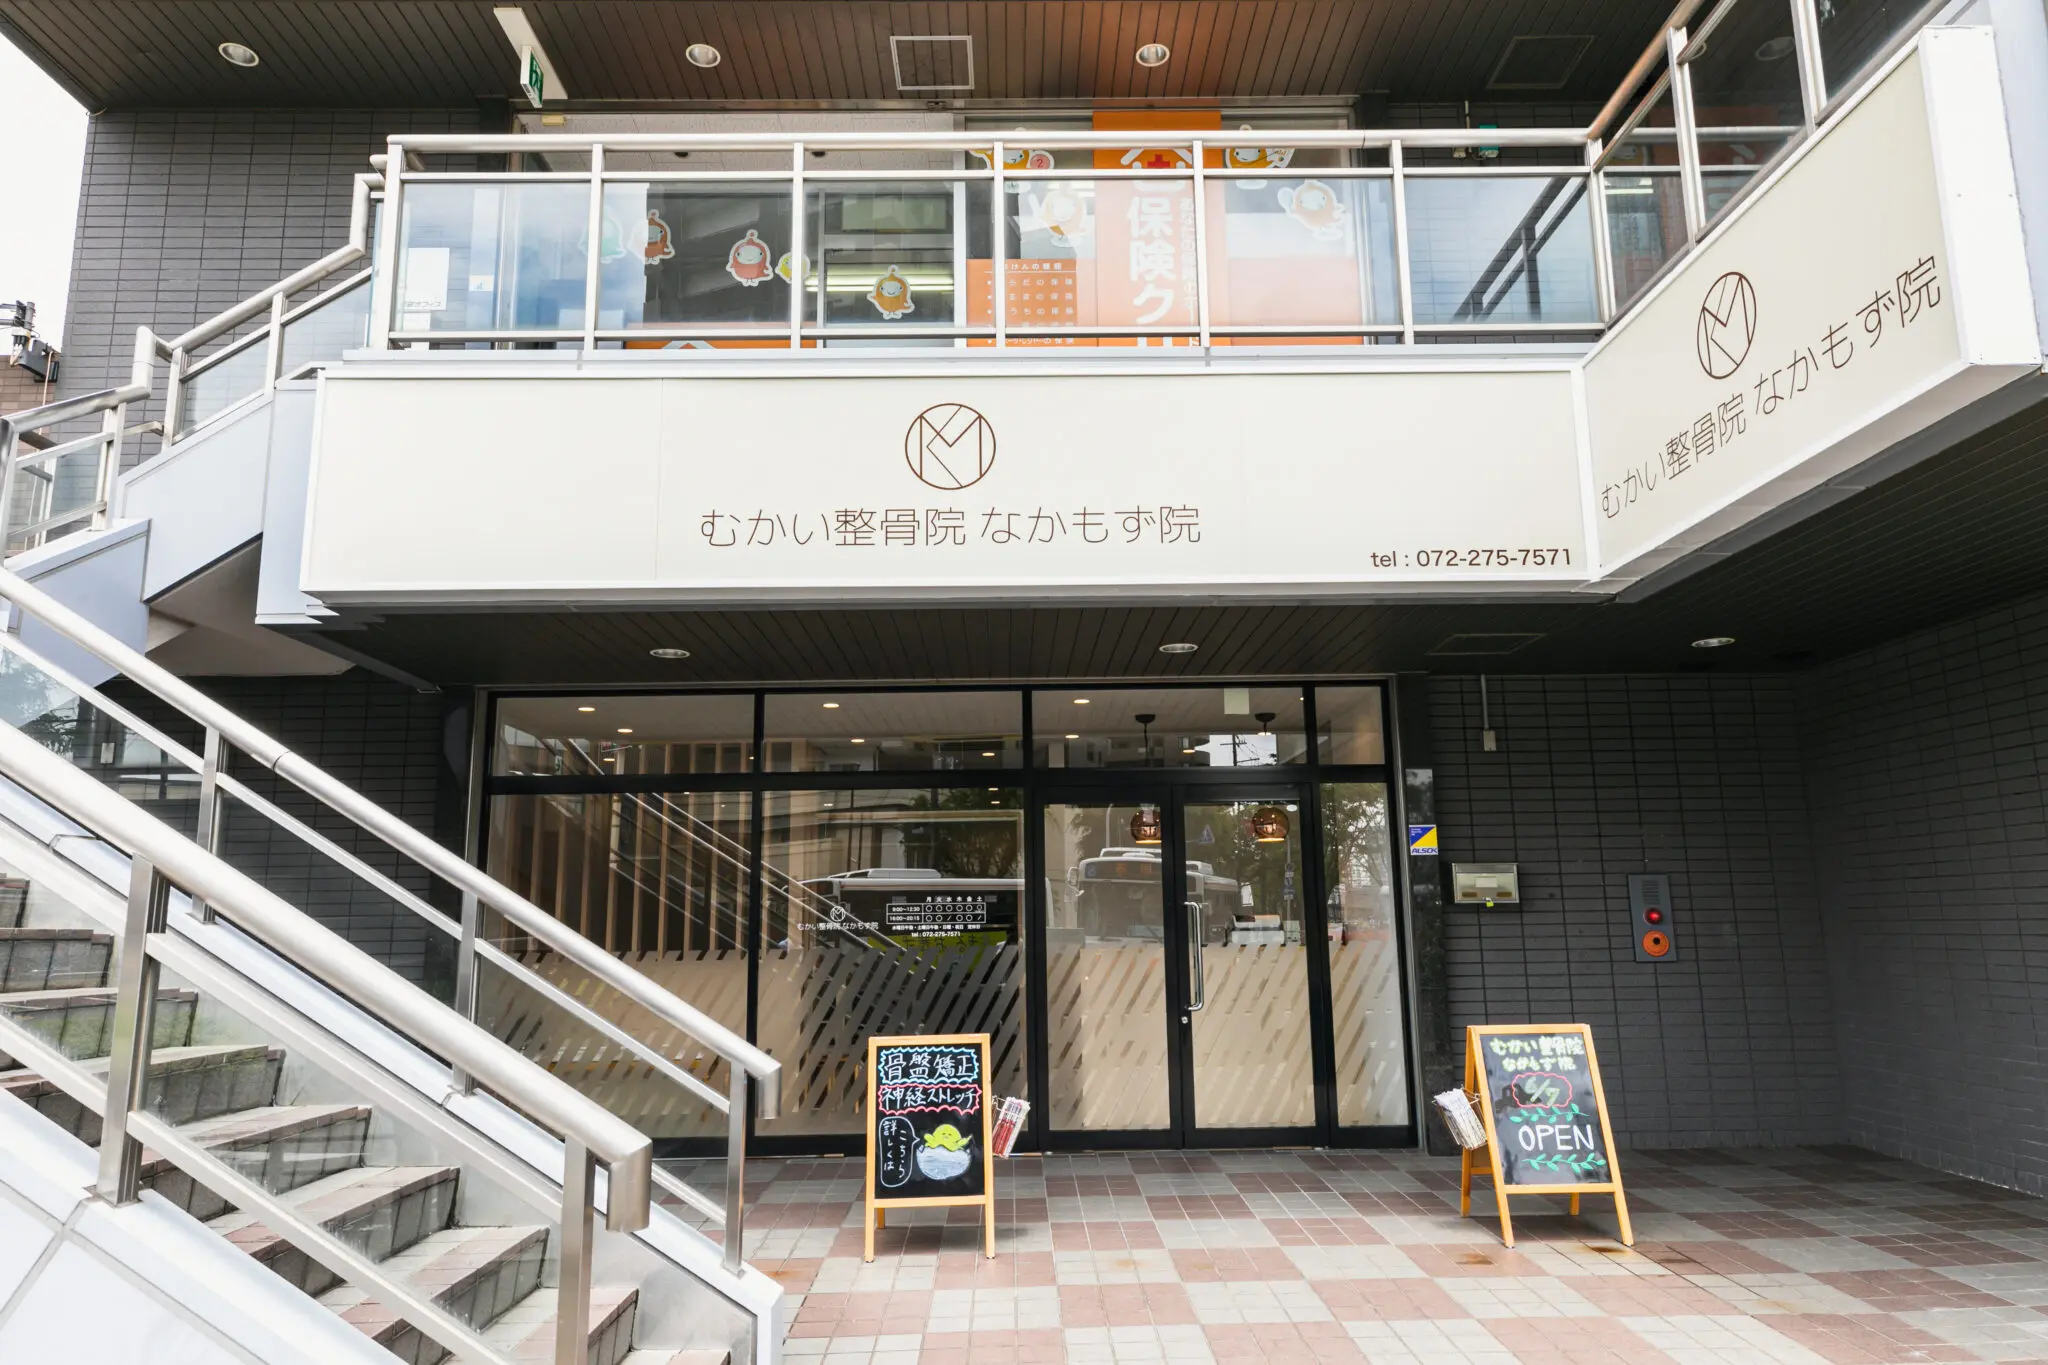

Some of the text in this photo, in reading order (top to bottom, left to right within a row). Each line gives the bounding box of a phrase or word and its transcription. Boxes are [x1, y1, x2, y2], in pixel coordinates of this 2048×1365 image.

[1601, 255, 1943, 519] むかい整骨院 なかもず院
[701, 504, 1201, 547] むかい整骨院 なかもず院
[1416, 548, 1571, 567] 072-275-7571
[885, 1052, 974, 1081] 骨盤矯正
[882, 1087, 976, 1110] 神経ストレッチ
[882, 1120, 898, 1171] 詳しくは
[897, 1129, 908, 1179] こちら
[1517, 1124, 1595, 1152] OPEN
